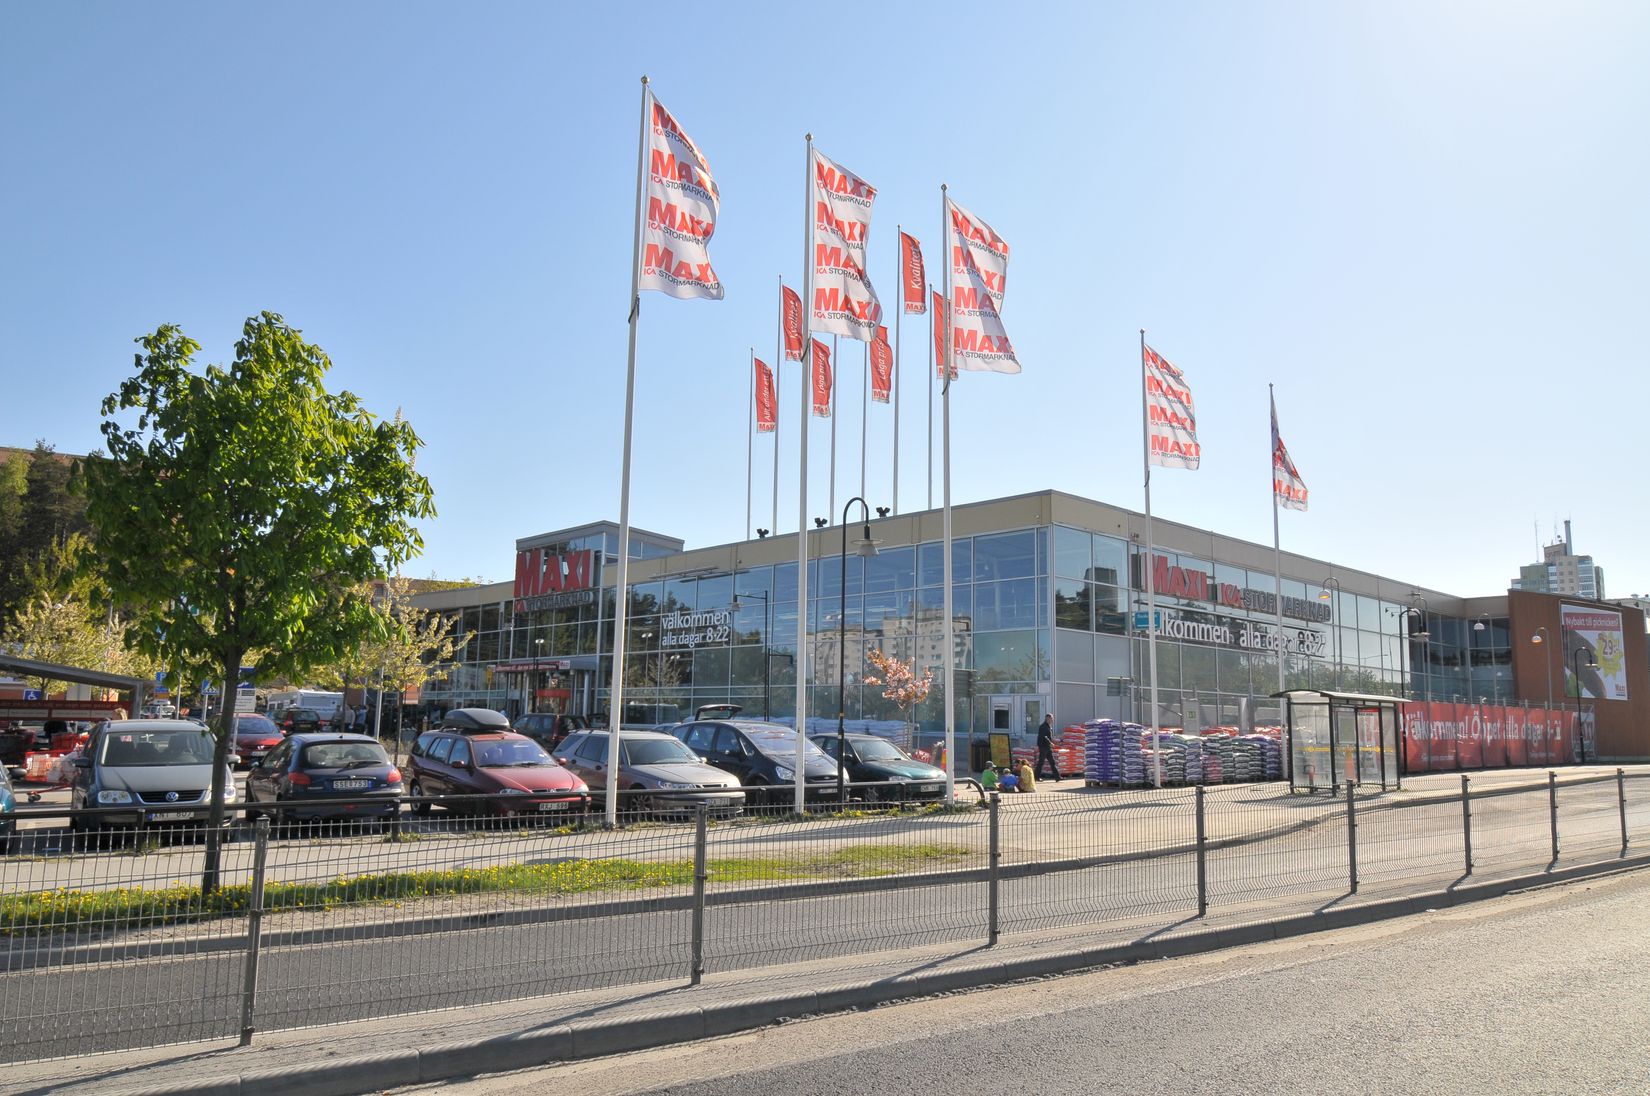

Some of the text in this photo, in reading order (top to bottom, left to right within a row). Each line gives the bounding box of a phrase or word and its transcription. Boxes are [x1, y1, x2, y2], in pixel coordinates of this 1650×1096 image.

[815, 288, 880, 321] MAXI
[1152, 435, 1200, 456] MAXI
[514, 548, 593, 598] MAXI
[1141, 552, 1208, 601] MAXI
[1218, 582, 1244, 609] ICA
[662, 610, 729, 630] välkommen
[662, 631, 677, 646] alla
[678, 628, 704, 648] dagar
[1240, 621, 1262, 649] alla
